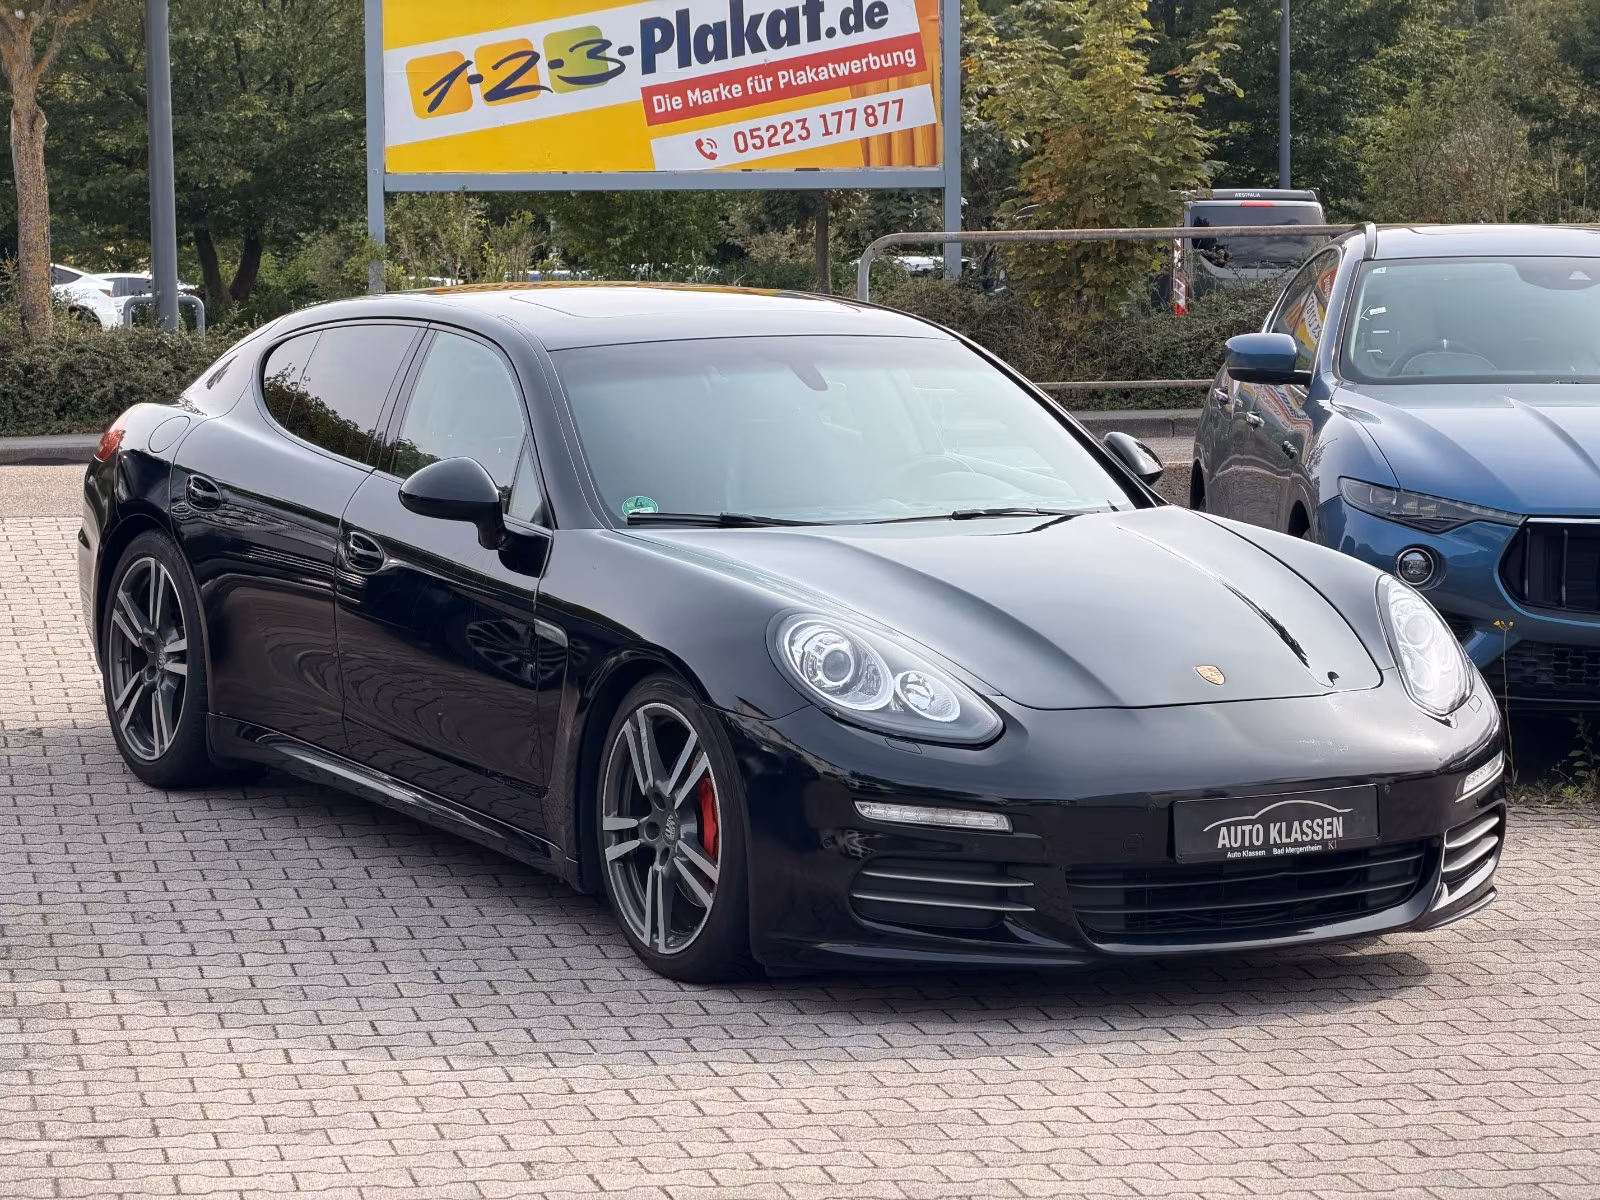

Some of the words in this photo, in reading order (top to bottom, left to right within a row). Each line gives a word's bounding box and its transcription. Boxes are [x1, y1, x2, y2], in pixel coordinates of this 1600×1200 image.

[652, 94, 683, 114] Die
[687, 83, 743, 108] Marke
[746, 76, 773, 96] für
[777, 48, 917, 88] Plakatwerbung
[733, 117, 811, 154] 05223
[819, 107, 858, 137] 177
[863, 98, 904, 128] 877
[1217, 823, 1264, 849] AUTO
[1269, 816, 1343, 845] KLASSEN
[1226, 850, 1242, 859] Auto
[1242, 849, 1266, 858] Klassen
[1272, 846, 1285, 855] Bad
[1285, 843, 1322, 855] Mergentheim
